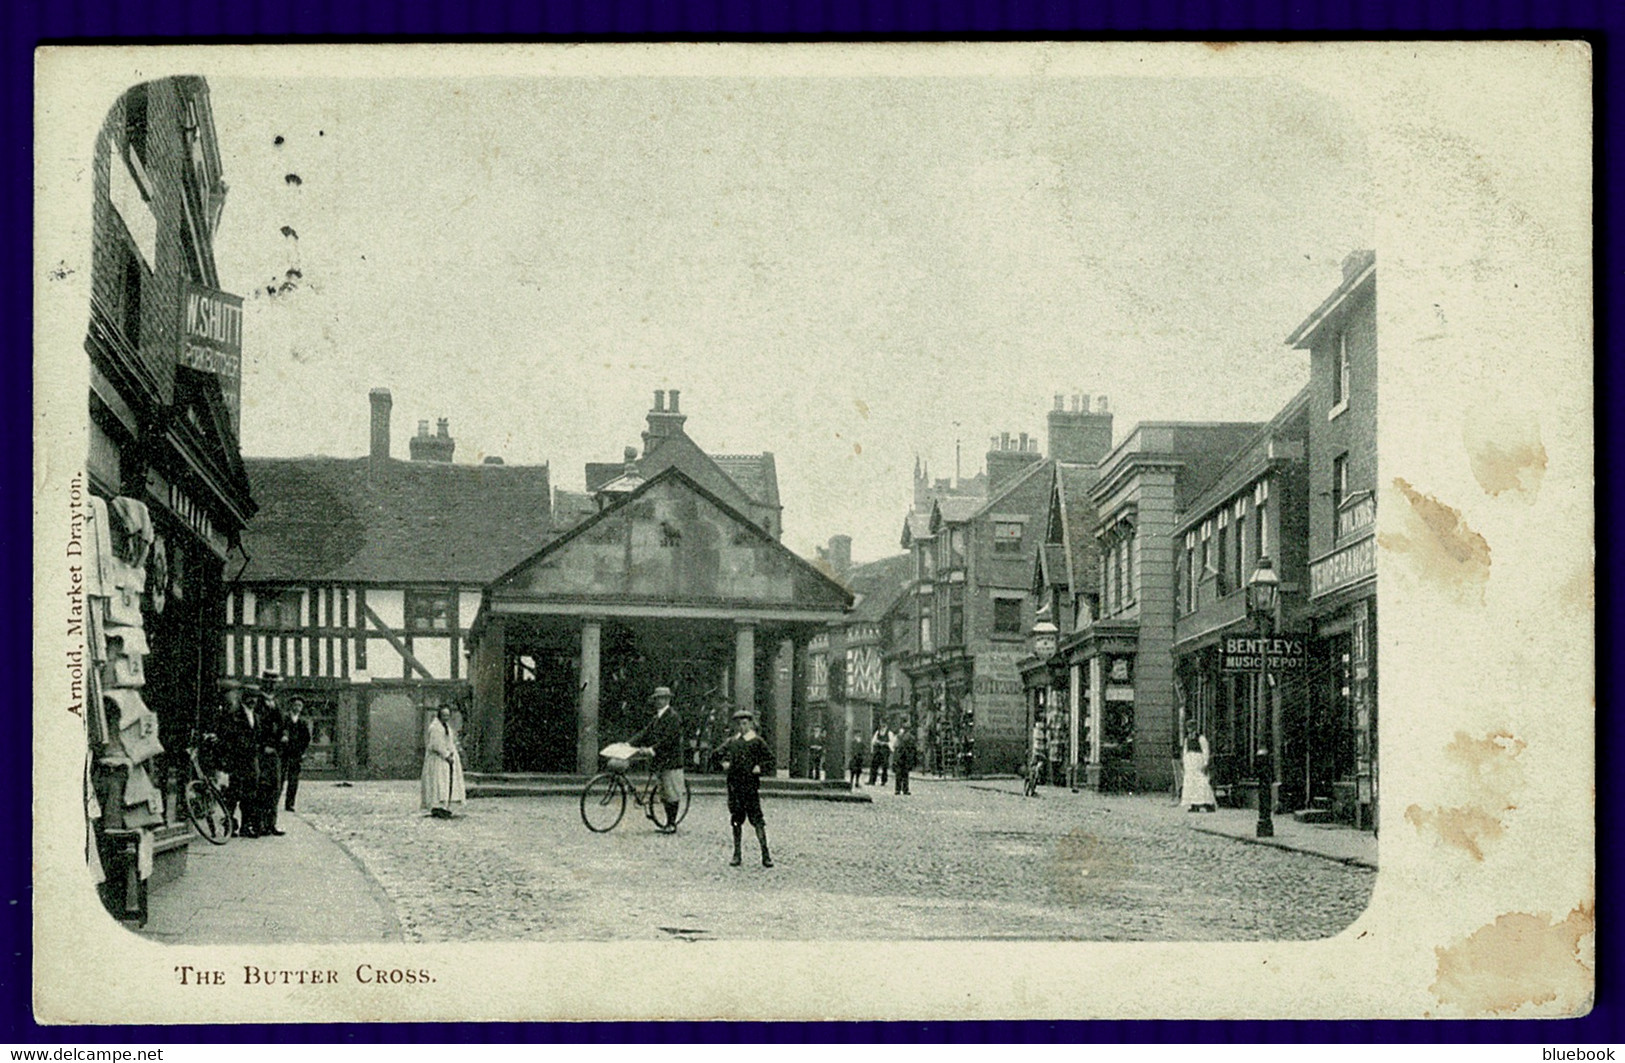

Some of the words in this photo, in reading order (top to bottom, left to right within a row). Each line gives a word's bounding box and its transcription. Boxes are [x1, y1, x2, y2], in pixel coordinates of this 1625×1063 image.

[67, 472, 87, 558] Drayton.
[67, 566, 82, 636] Market
[1226, 656, 1262, 668] MUSIC
[1227, 639, 1303, 654] BENTLEYS
[67, 644, 85, 722] Arnold,
